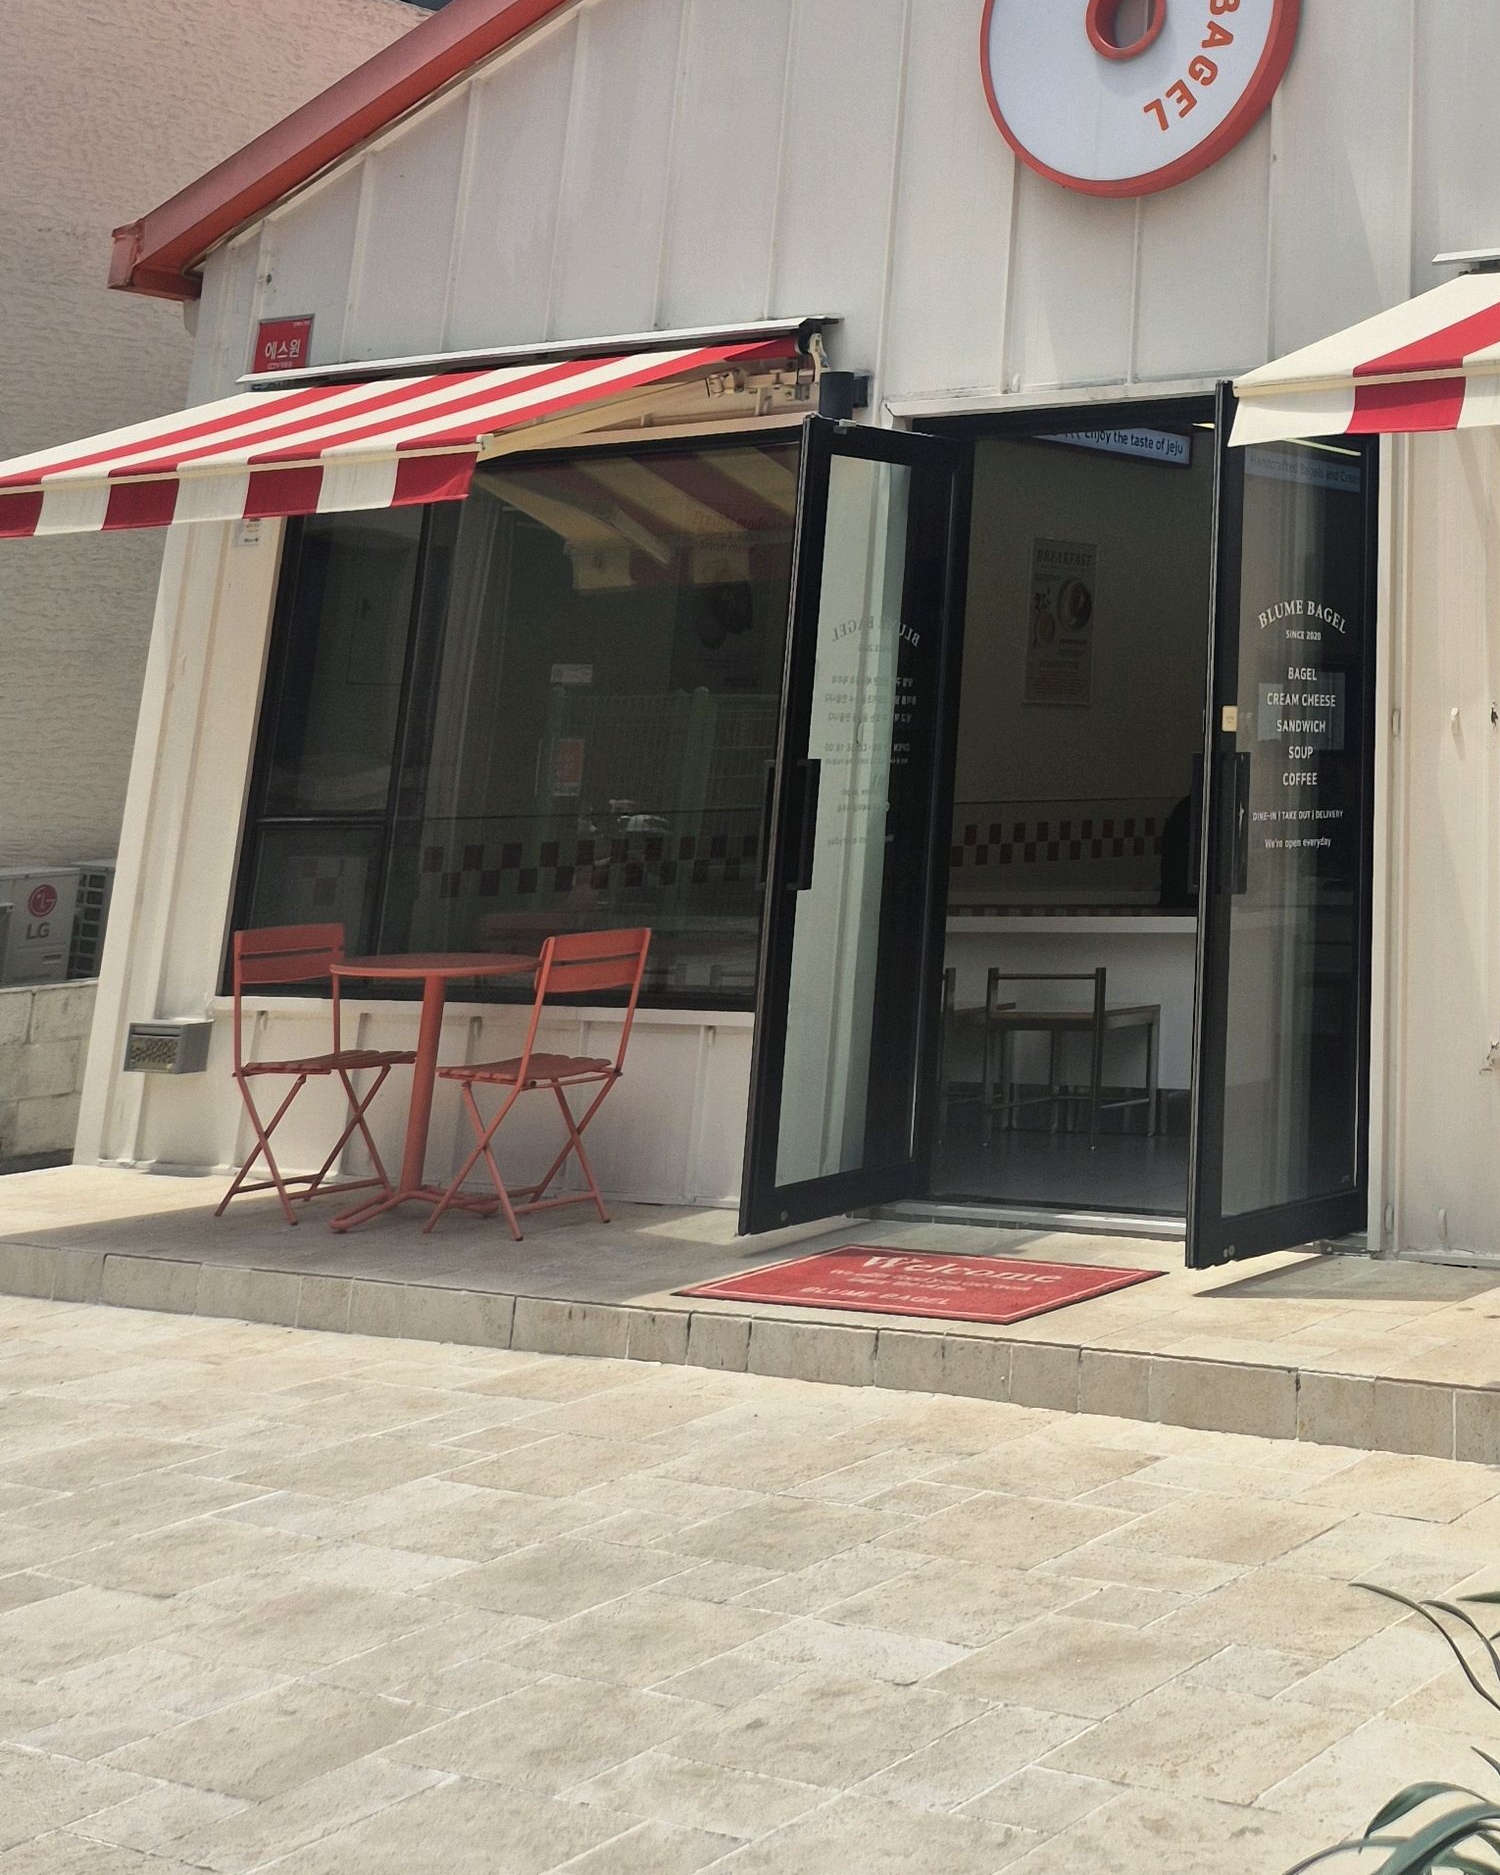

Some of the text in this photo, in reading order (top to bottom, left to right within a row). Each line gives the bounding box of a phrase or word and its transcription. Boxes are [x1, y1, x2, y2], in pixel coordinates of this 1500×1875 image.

[265, 339, 301, 360] 에스원
[1113, 430, 1129, 445] the
[1130, 434, 1154, 450] taste
[1155, 438, 1166, 451] of
[1036, 548, 1093, 567] BREAKFAST
[1258, 599, 1346, 634] BLUME BAGEL
[1285, 629, 1322, 641] SINCE 2020
[1288, 666, 1318, 681] BAGEL
[1267, 692, 1337, 707] CREAM CHEESE
[1276, 719, 1326, 733] SANDWICH
[1288, 745, 1314, 759] SOUP
[1282, 772, 1318, 786] COFFEE
[1252, 809, 1344, 822] DINE-IN TAKE OUT DELIVERY
[1284, 839, 1301, 850] open
[1302, 836, 1331, 849] everyday
[26, 922, 50, 939] LG
[862, 1256, 1062, 1283] Welcome
[800, 1287, 951, 1306] BLUME BAGEL
